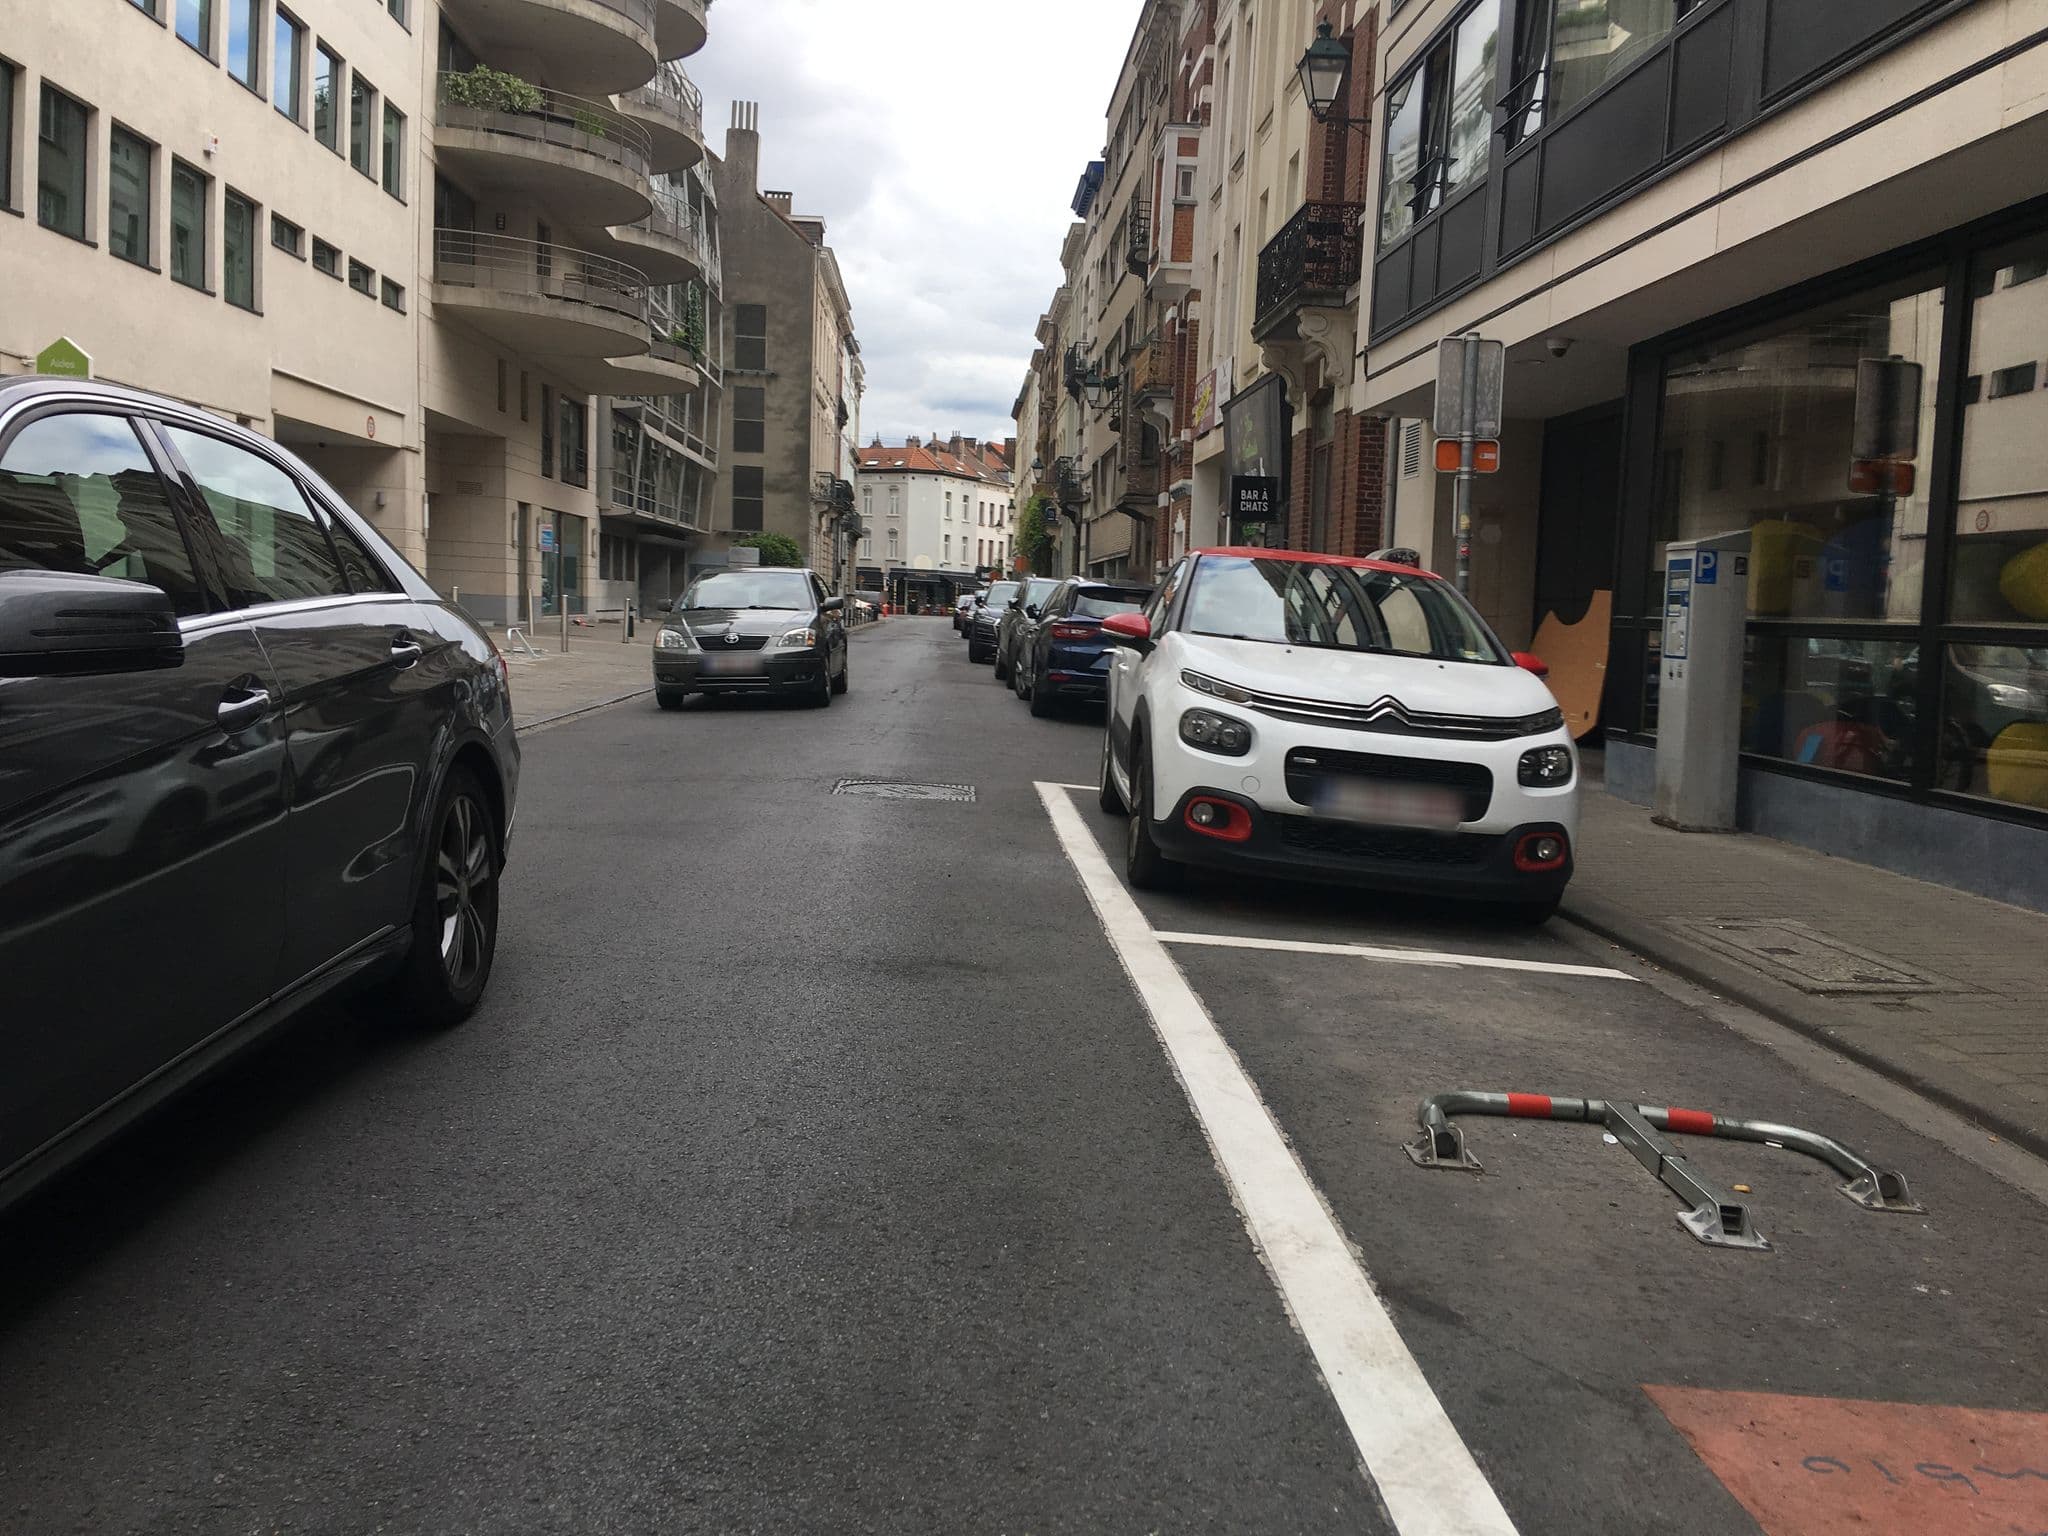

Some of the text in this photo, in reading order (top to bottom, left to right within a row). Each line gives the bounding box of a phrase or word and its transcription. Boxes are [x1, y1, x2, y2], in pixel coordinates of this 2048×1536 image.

[1240, 488, 1268, 500] BAR À
[1240, 501, 1269, 511] CHATS
[1697, 552, 1715, 577] P
